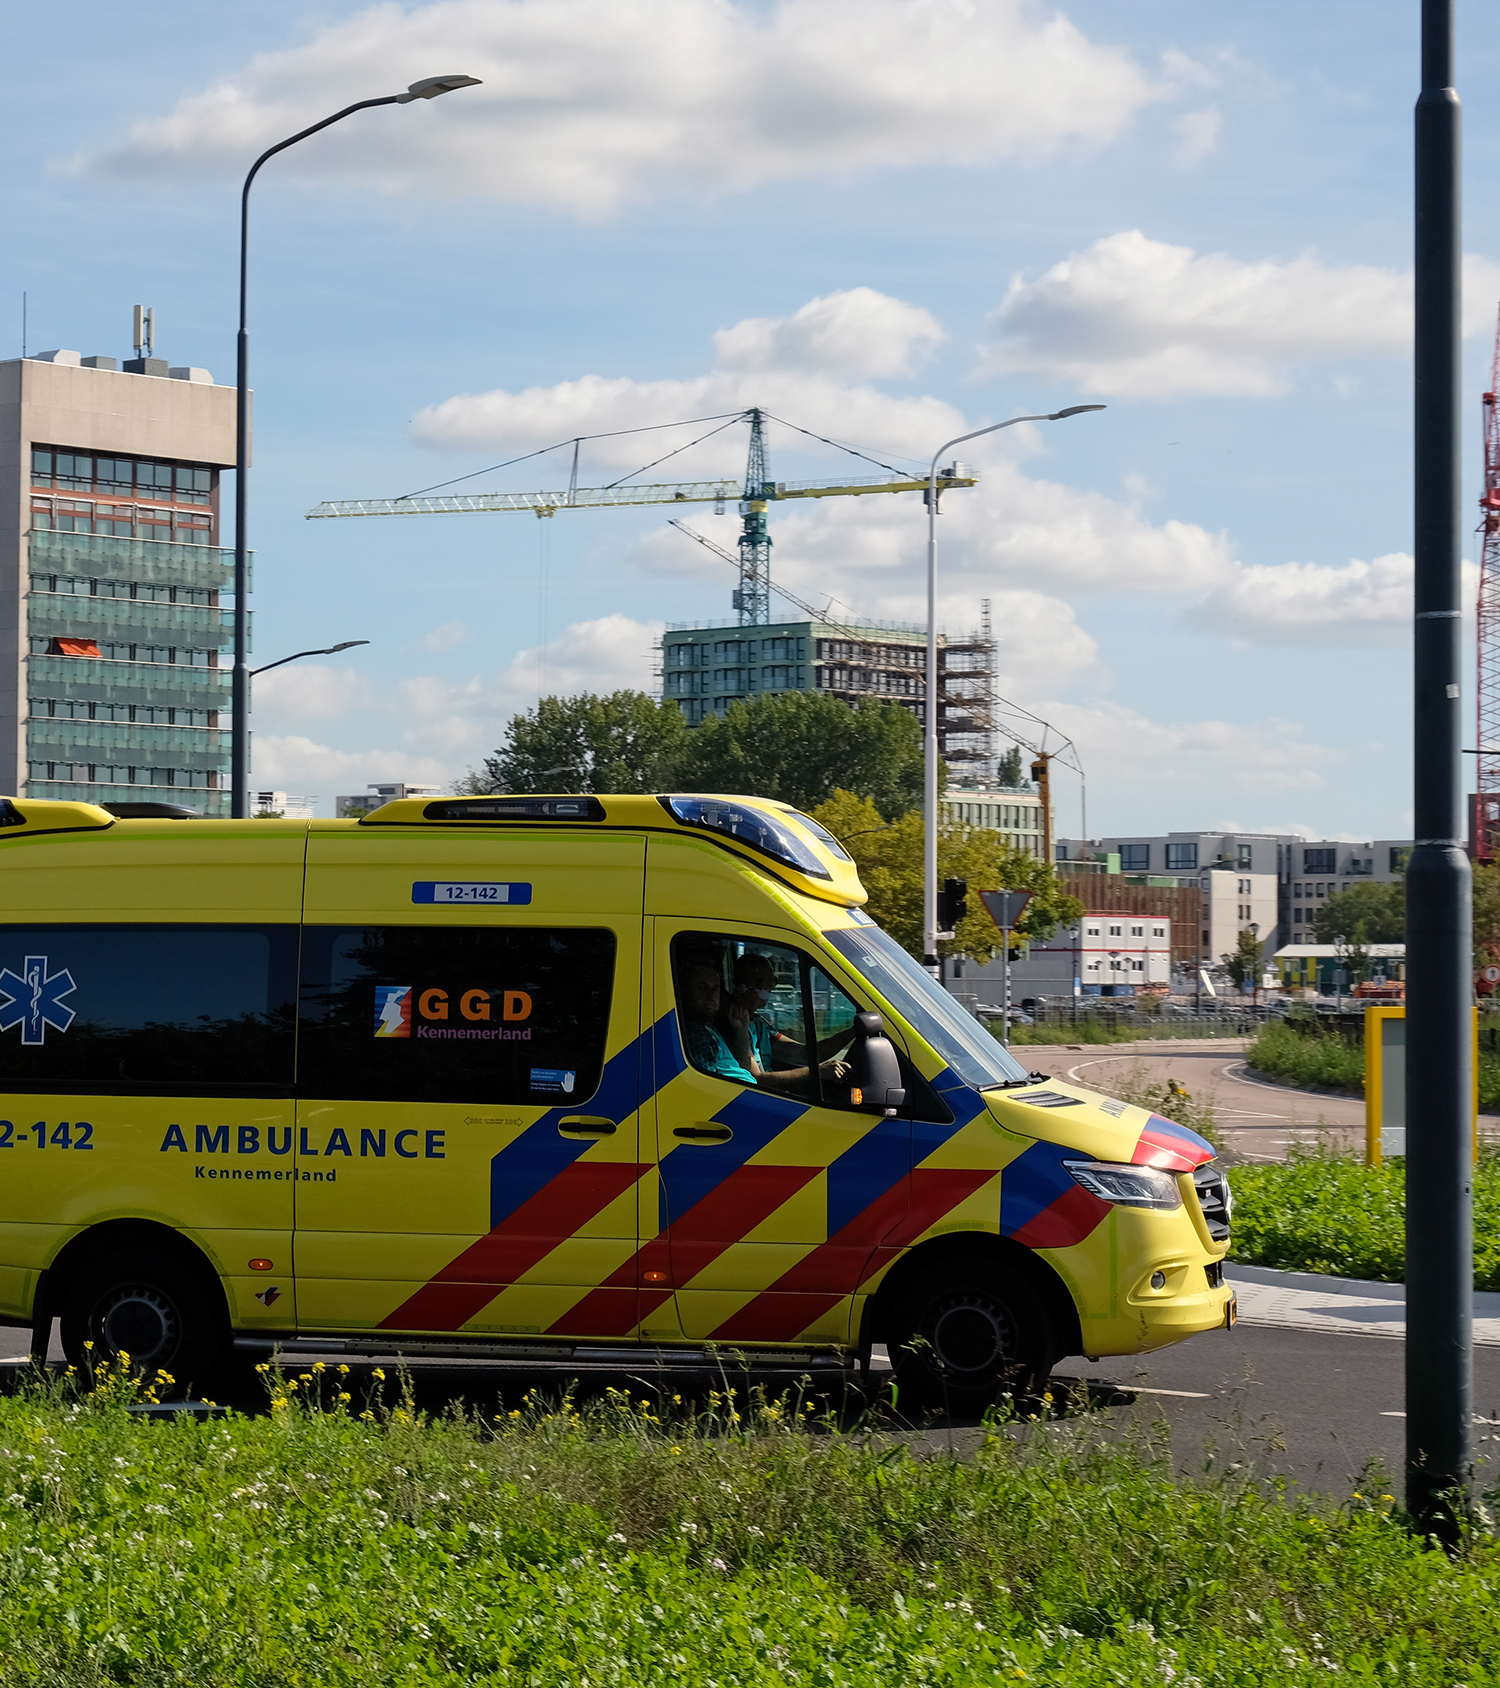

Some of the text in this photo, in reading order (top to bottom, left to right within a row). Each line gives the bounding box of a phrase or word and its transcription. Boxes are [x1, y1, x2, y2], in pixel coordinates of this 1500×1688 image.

[446, 886, 498, 900] 12-142
[417, 1025, 531, 1041] Kennemerland
[160, 1123, 446, 1159] AMBULANCE
[194, 1165, 337, 1183] Kennemerland
